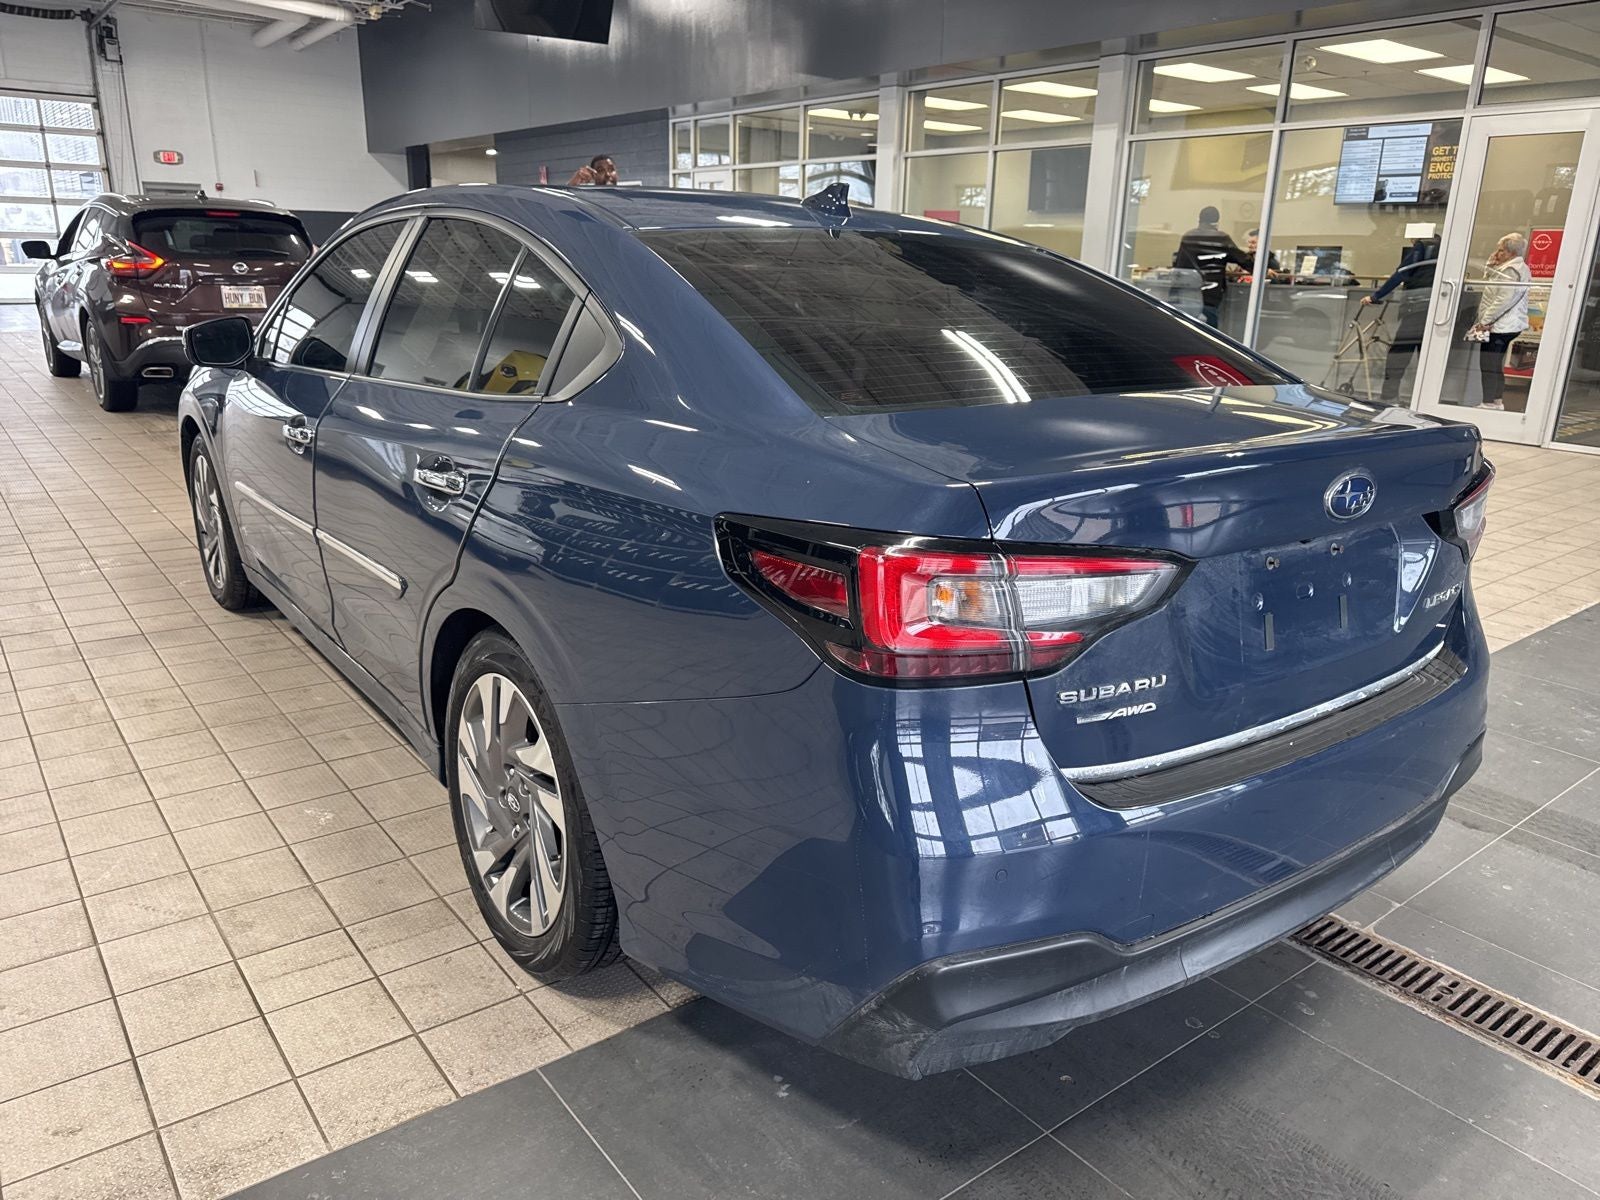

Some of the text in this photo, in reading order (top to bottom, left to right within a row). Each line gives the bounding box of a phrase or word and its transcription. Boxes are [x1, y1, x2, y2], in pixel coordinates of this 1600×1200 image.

[1432, 146, 1451, 155] GET
[224, 292, 243, 304] HUNY
[1059, 674, 1167, 705] SUBARU
[1107, 701, 1157, 720] AWD
